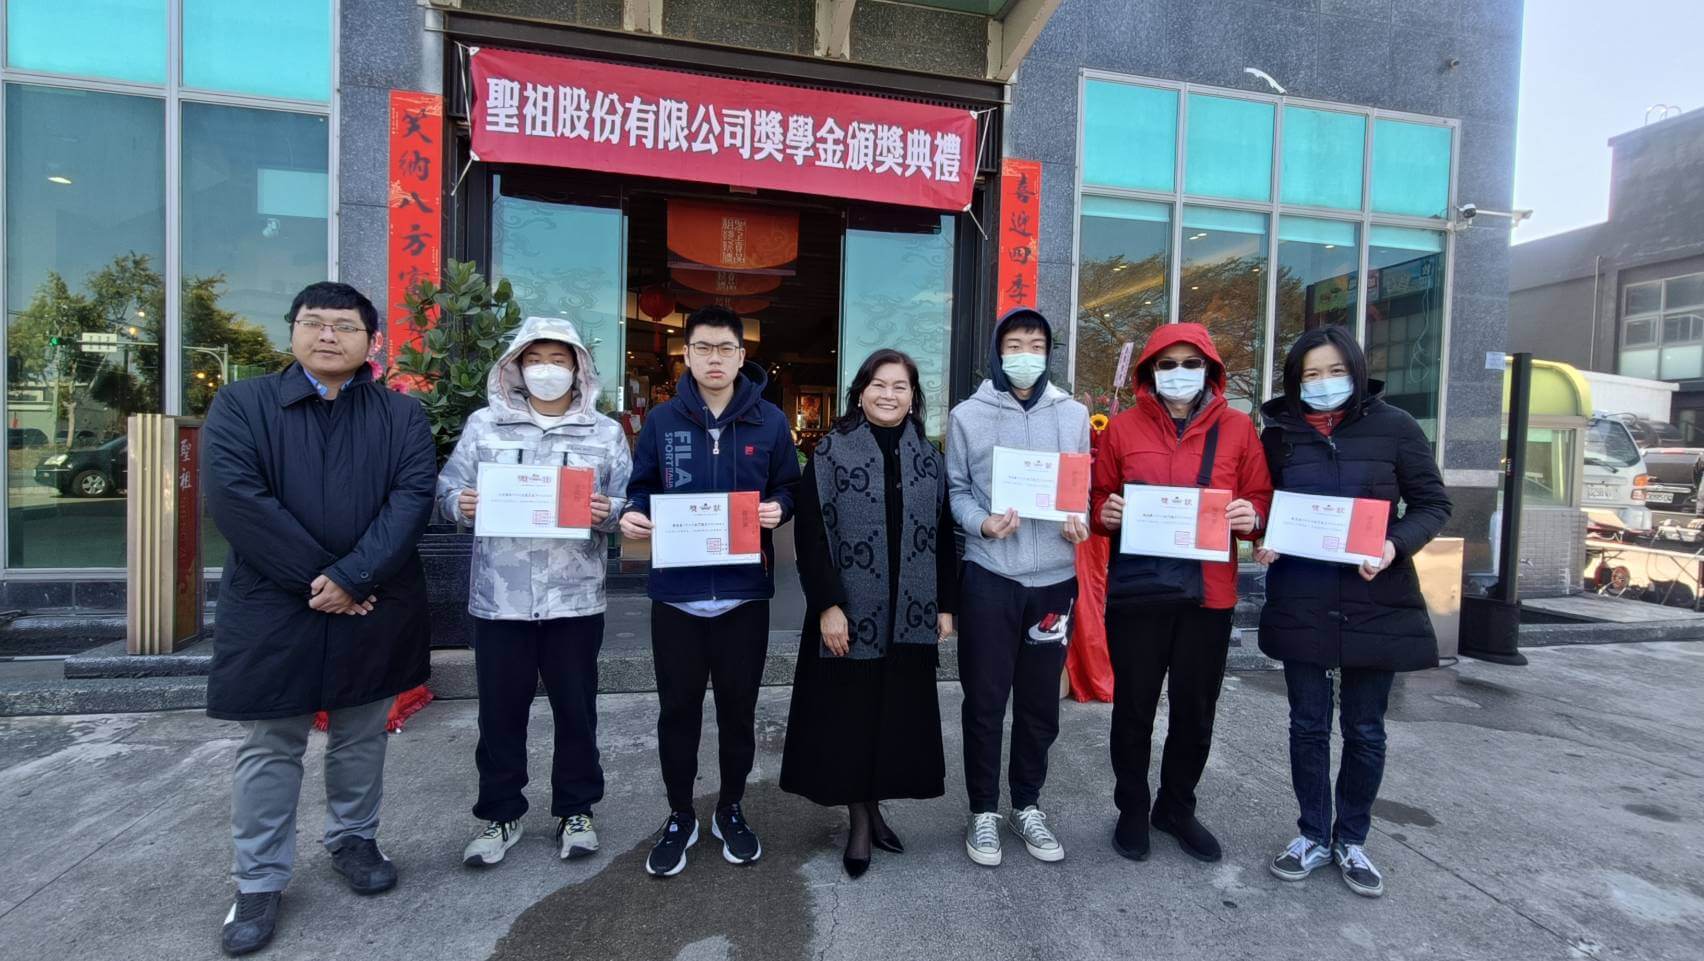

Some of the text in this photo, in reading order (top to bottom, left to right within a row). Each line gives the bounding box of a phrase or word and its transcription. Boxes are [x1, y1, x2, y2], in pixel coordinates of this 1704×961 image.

[485, 77, 962, 183] 聖祖股份有限公司獎學金頒獎典禮
[179, 438, 192, 490] 聖祖
[664, 432, 674, 467] SPORT
[674, 430, 692, 488] FILA
